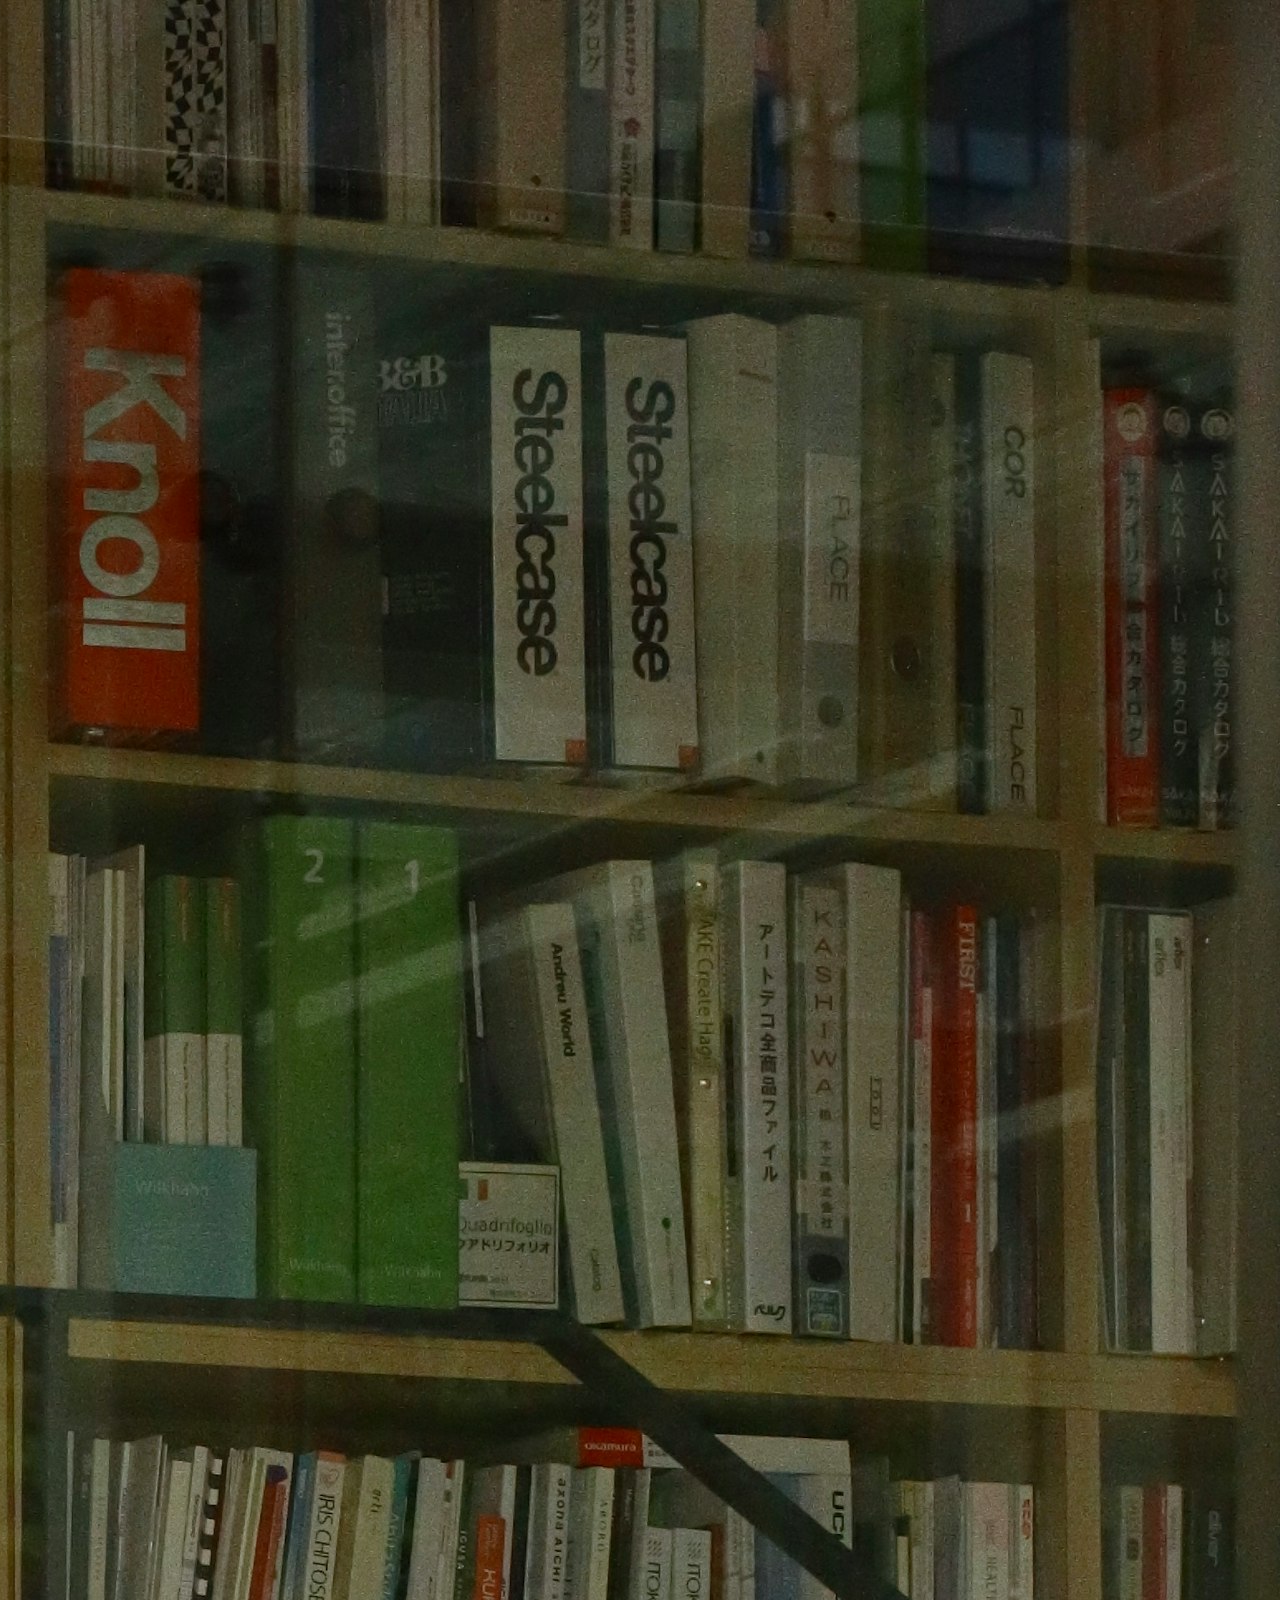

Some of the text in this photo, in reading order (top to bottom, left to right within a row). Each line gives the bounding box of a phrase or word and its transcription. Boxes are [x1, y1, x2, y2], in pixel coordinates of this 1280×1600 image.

[79, 348, 187, 652] Knoll
[1004, 425, 1027, 499] COR
[514, 367, 569, 677] Steelcase
[625, 376, 676, 684] Steelcase
[1008, 706, 1026, 802] FLACE
[305, 849, 325, 884] 2
[403, 859, 420, 898] 1
[550, 942, 577, 1059] Andreu World
[813, 910, 838, 1095] KASHIWA
[318, 1493, 338, 1523] IRIS
